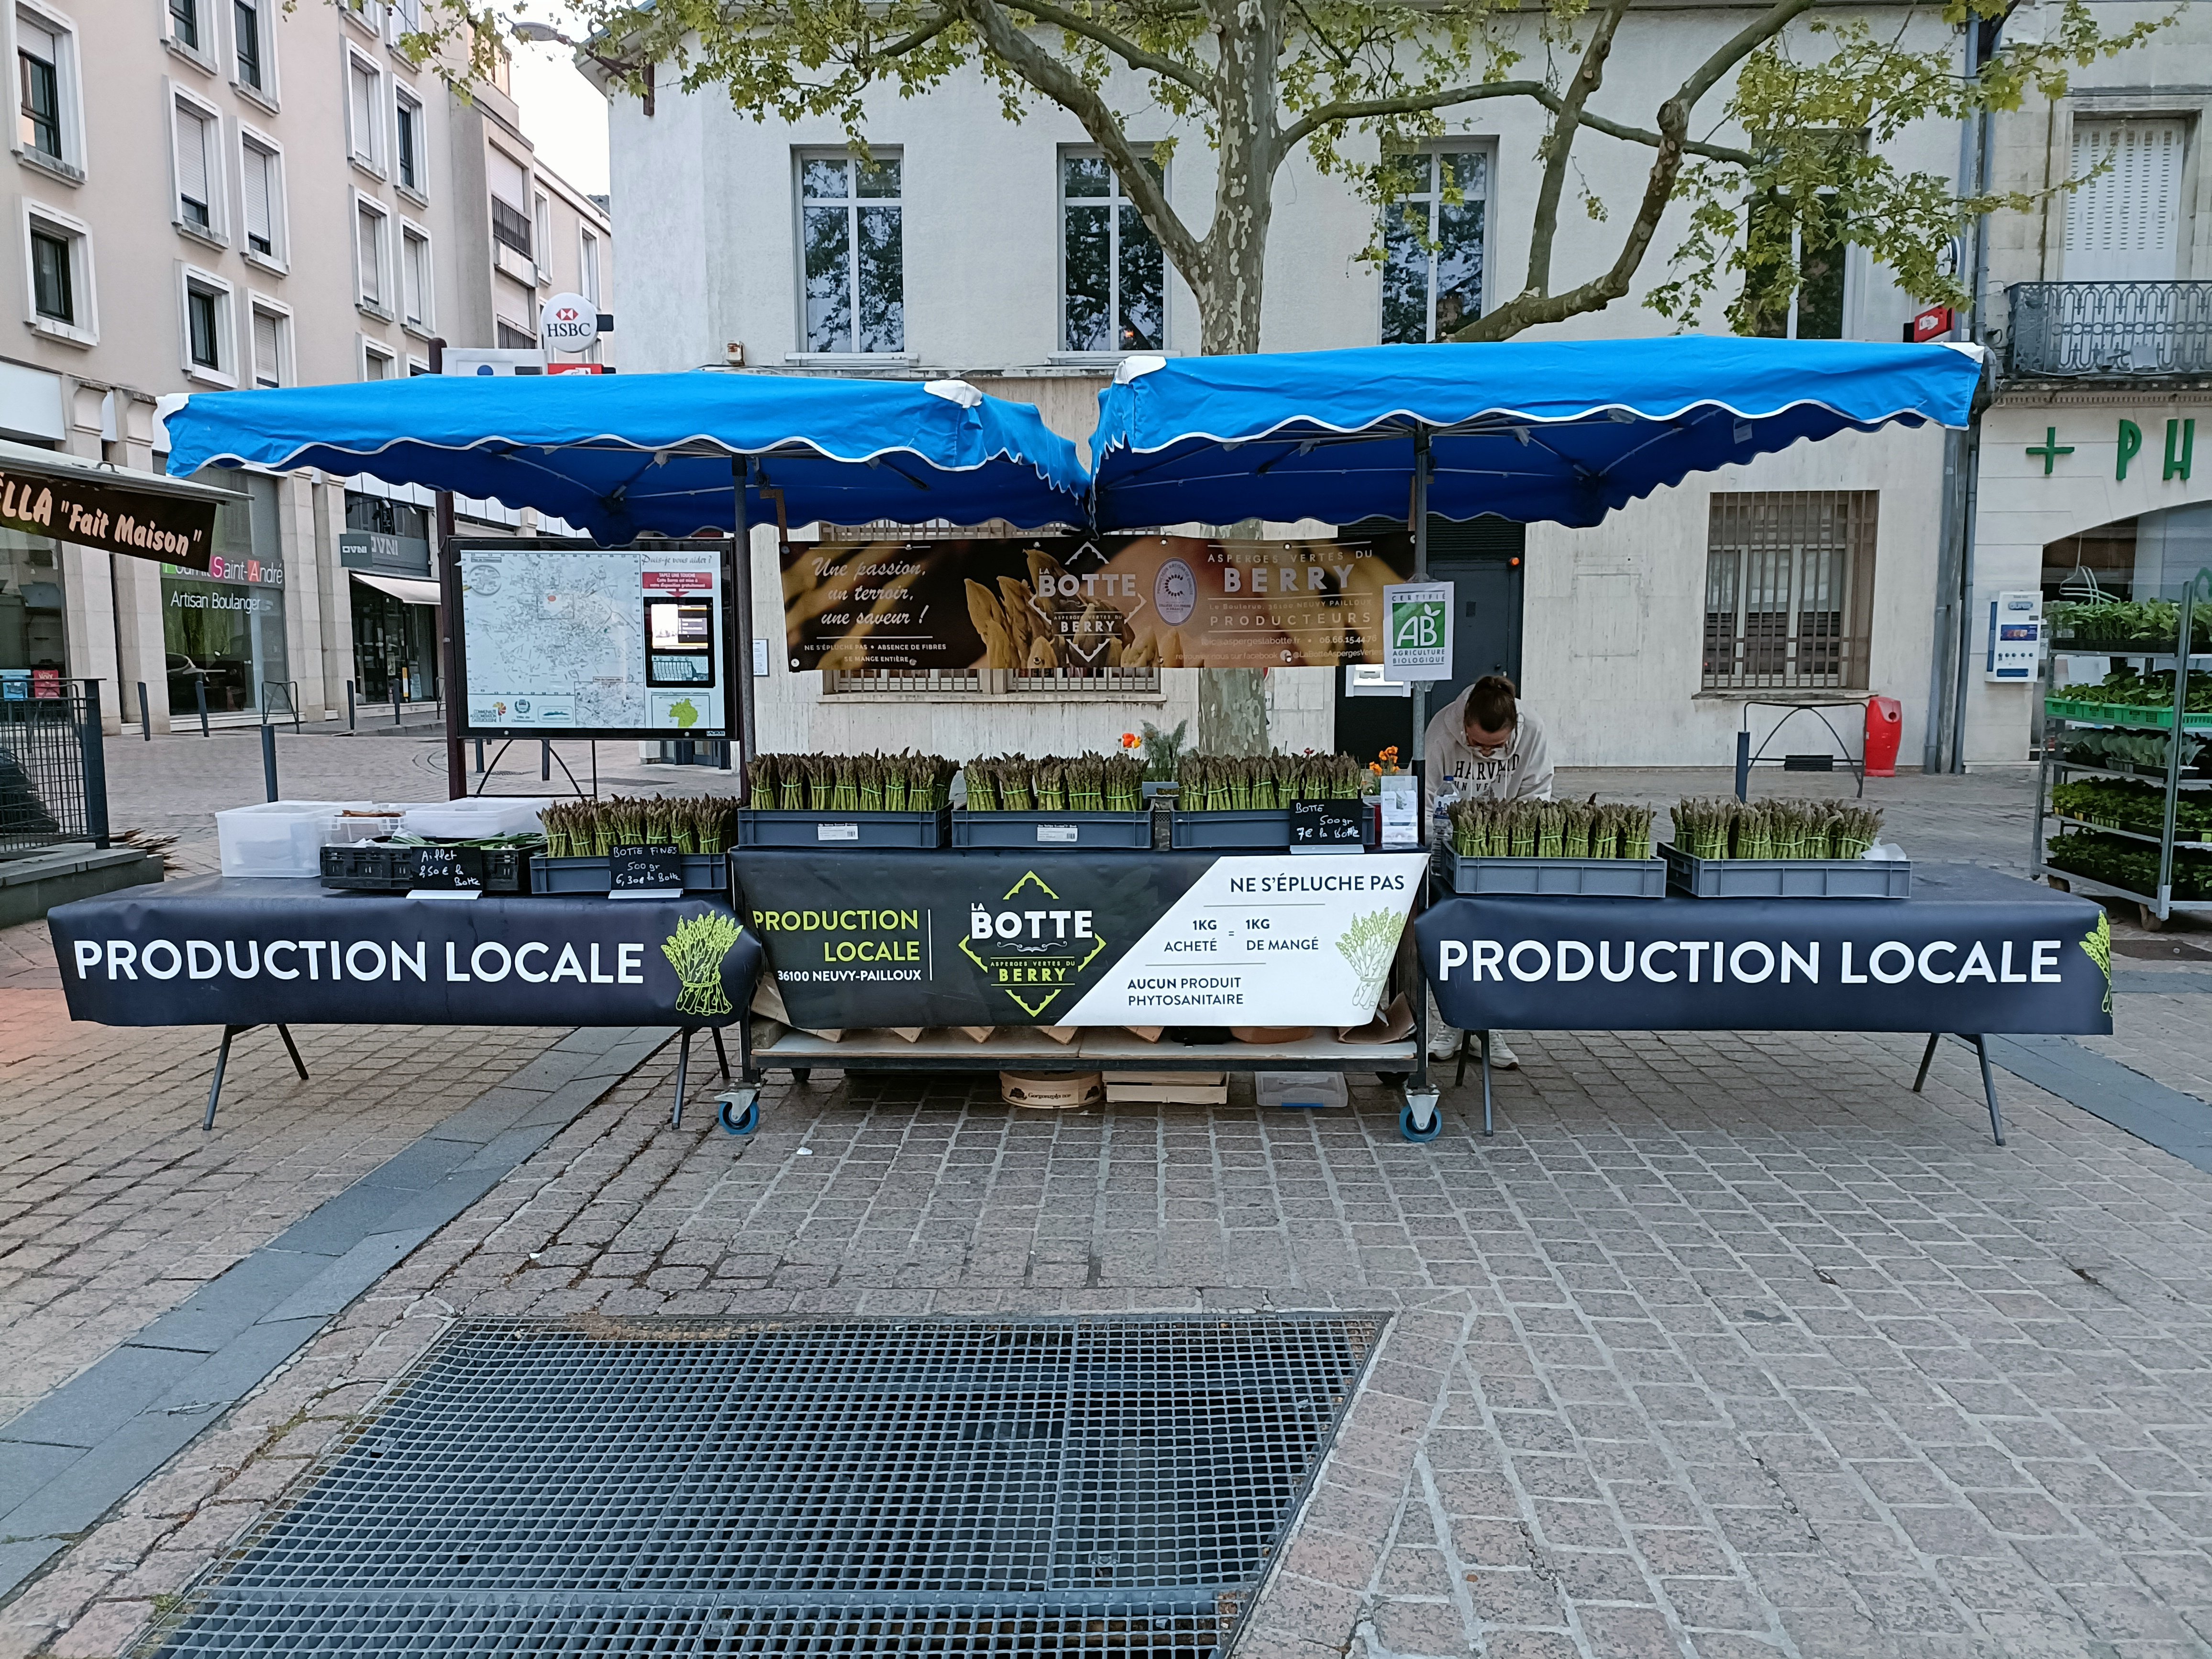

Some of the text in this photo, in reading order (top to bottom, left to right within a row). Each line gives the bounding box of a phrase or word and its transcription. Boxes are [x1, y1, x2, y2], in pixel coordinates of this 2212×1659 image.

[547, 323, 591, 337] HSBC
[0, 472, 52, 526] LLA
[641, 554, 670, 565] Puis-je
[1207, 550, 1372, 563] ASPERGES VERTES DU
[812, 557, 925, 581] Une passion,
[1224, 564, 1354, 592] BERRY
[1039, 574, 1136, 597] BOTTE
[828, 586, 913, 601] un terroir,
[1392, 592, 1445, 601] CERTIFIÉ
[170, 591, 260, 614] Artisan Boulanger
[821, 605, 929, 624] une saveur !
[1210, 612, 1370, 626] PRODUCTEURS
[1061, 621, 1115, 632] BERRY
[1397, 616, 1437, 646] AB
[1297, 827, 1313, 841] 7€
[1319, 828, 1327, 838] la
[421, 849, 457, 863] Aillet
[614, 847, 677, 857] BOTTE FINES
[454, 877, 480, 886] Botte
[647, 871, 654, 881] la
[658, 873, 681, 882] Botte
[1230, 873, 1405, 893] NE S'ÉPLUCHE PAS
[972, 903, 985, 911] LA
[752, 909, 918, 931] PRODUCTION
[972, 910, 1092, 939] BOTTE
[1192, 919, 1217, 931] 1KG
[1246, 918, 1271, 930] 1KG
[1164, 936, 1319, 952] ACHETÉ DE MANGÉ
[824, 941, 920, 962] LOCALE
[74, 940, 644, 984] PRODUCTION LOCALE
[1438, 940, 2062, 984] PRODUCTION LOCALE
[777, 970, 921, 982] 36100 NEUVY-PAILLOUX
[999, 968, 1066, 982] BERRY
[1128, 977, 1241, 990] AUCUN PRODUIT
[1128, 994, 1243, 1006] PHYTOSANITAIRE
